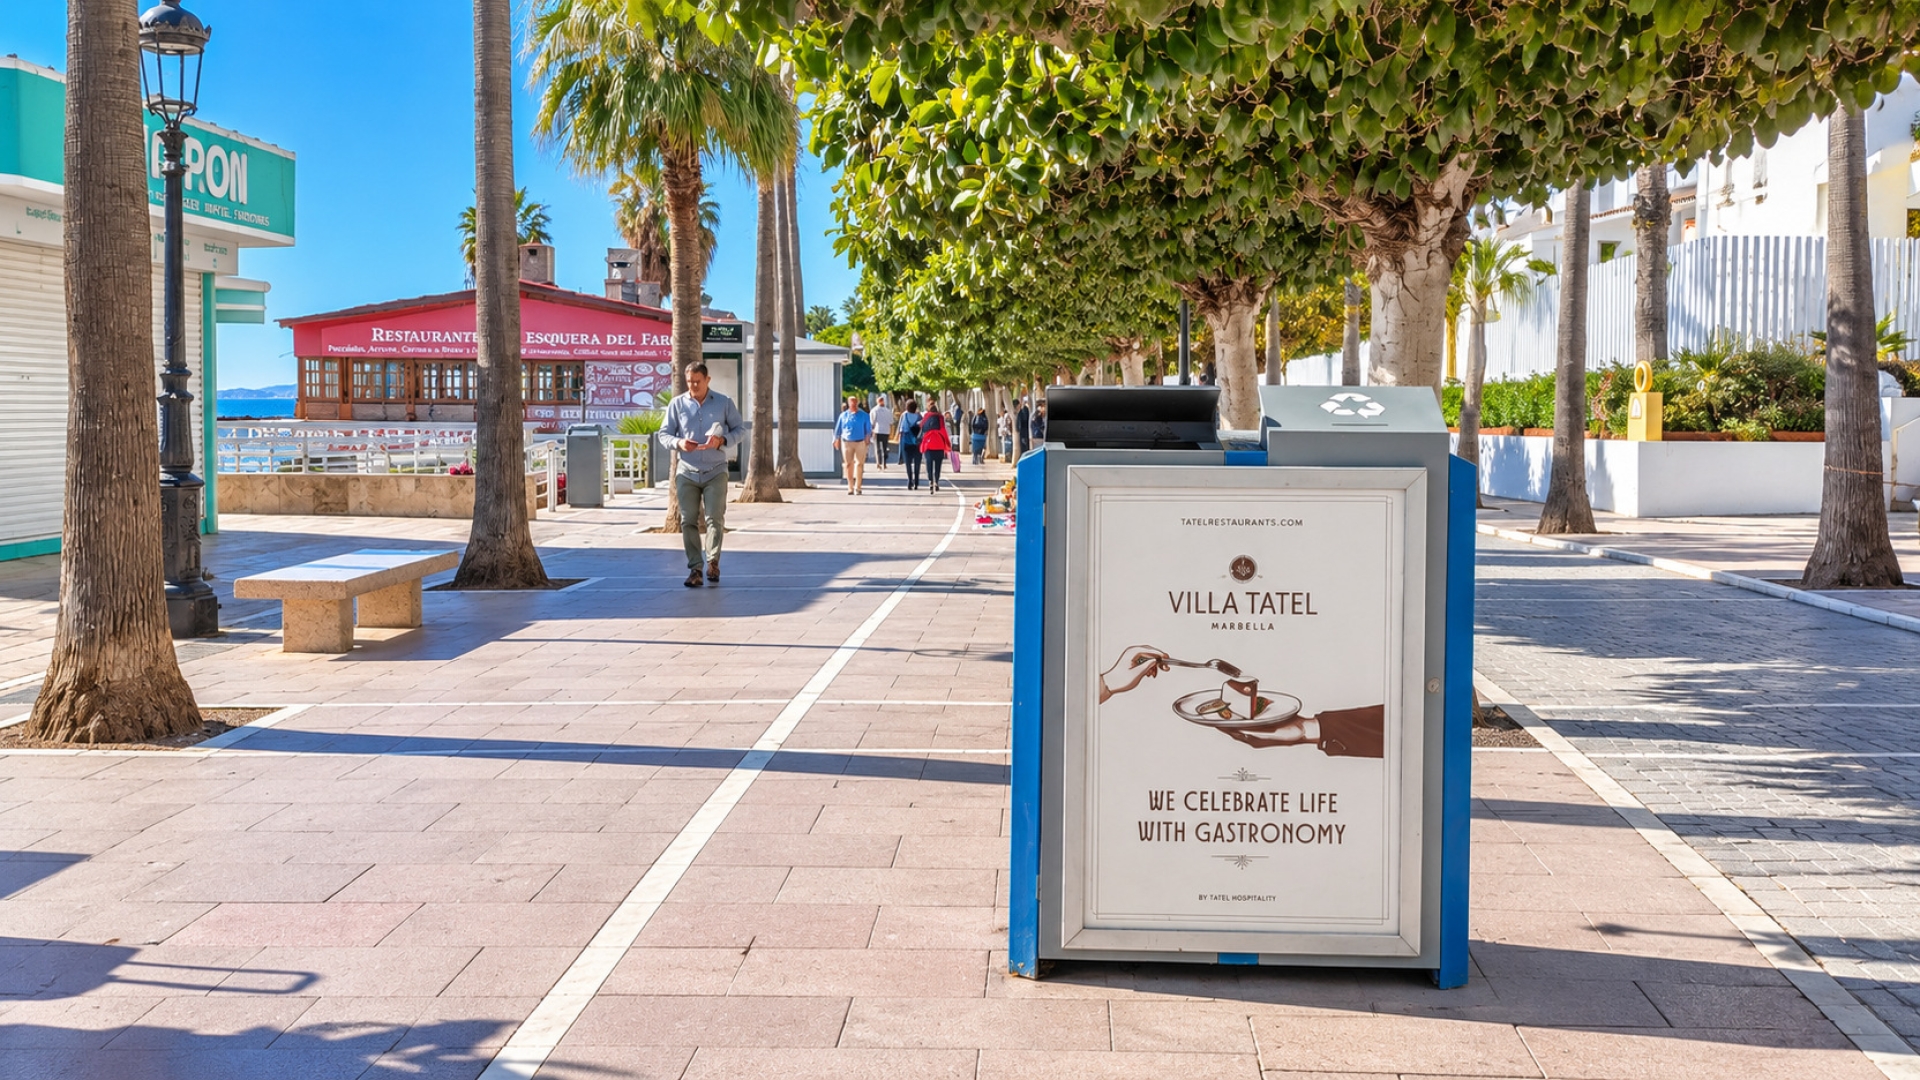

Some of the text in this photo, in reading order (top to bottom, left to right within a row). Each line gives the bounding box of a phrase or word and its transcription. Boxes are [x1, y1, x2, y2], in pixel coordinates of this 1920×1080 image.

[524, 331, 602, 347] ESQUERA
[606, 334, 636, 346] DEL
[1181, 518, 1303, 527] TATELRESTAURANTS.COM
[1168, 590, 1318, 615] VILLA TATEL
[1211, 621, 1275, 631] MARBELLA
[1148, 789, 1338, 814] WE CELEBRATE LIFE
[1138, 820, 1347, 845] WITH GASTRONOMY
[1198, 894, 1277, 902] BY TATEL HOSPITALITY
